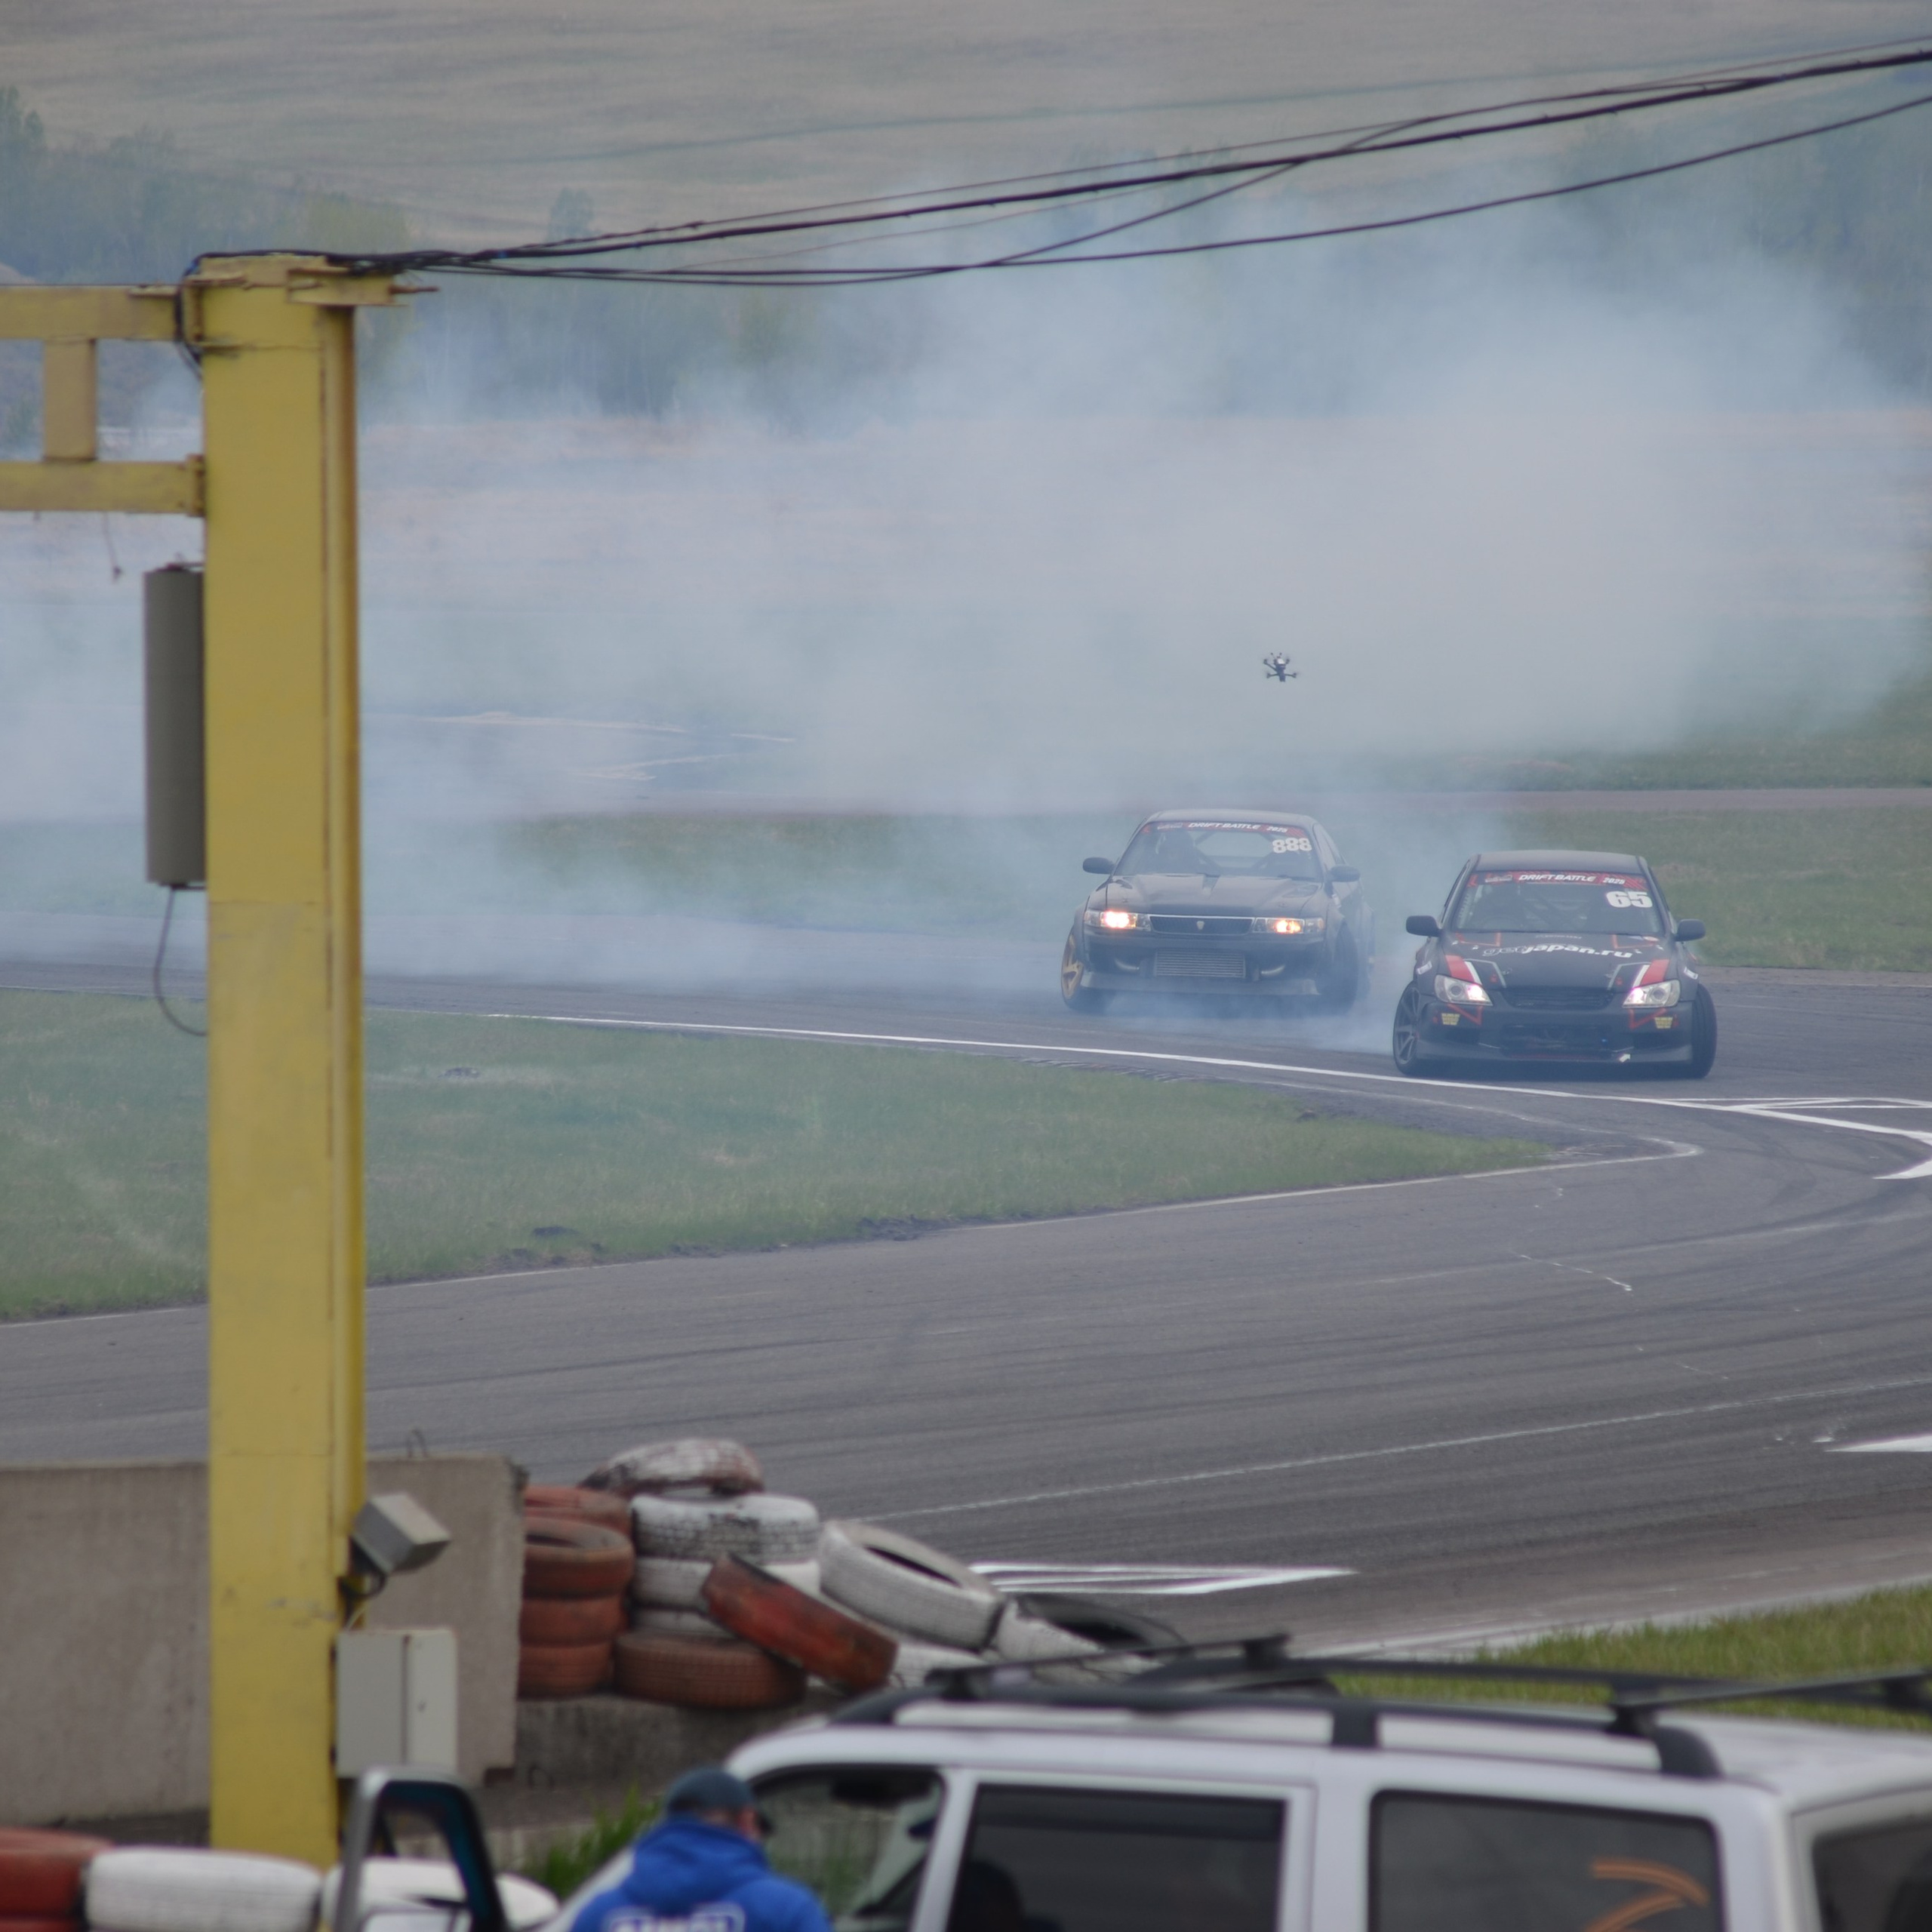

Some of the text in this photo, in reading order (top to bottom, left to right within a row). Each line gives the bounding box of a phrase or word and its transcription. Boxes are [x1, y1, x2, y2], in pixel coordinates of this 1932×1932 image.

[1272, 837, 1312, 854] 888
[1554, 874, 1596, 882] BATTLE
[1603, 877, 1626, 885] 2025
[1605, 891, 1653, 908] 65
